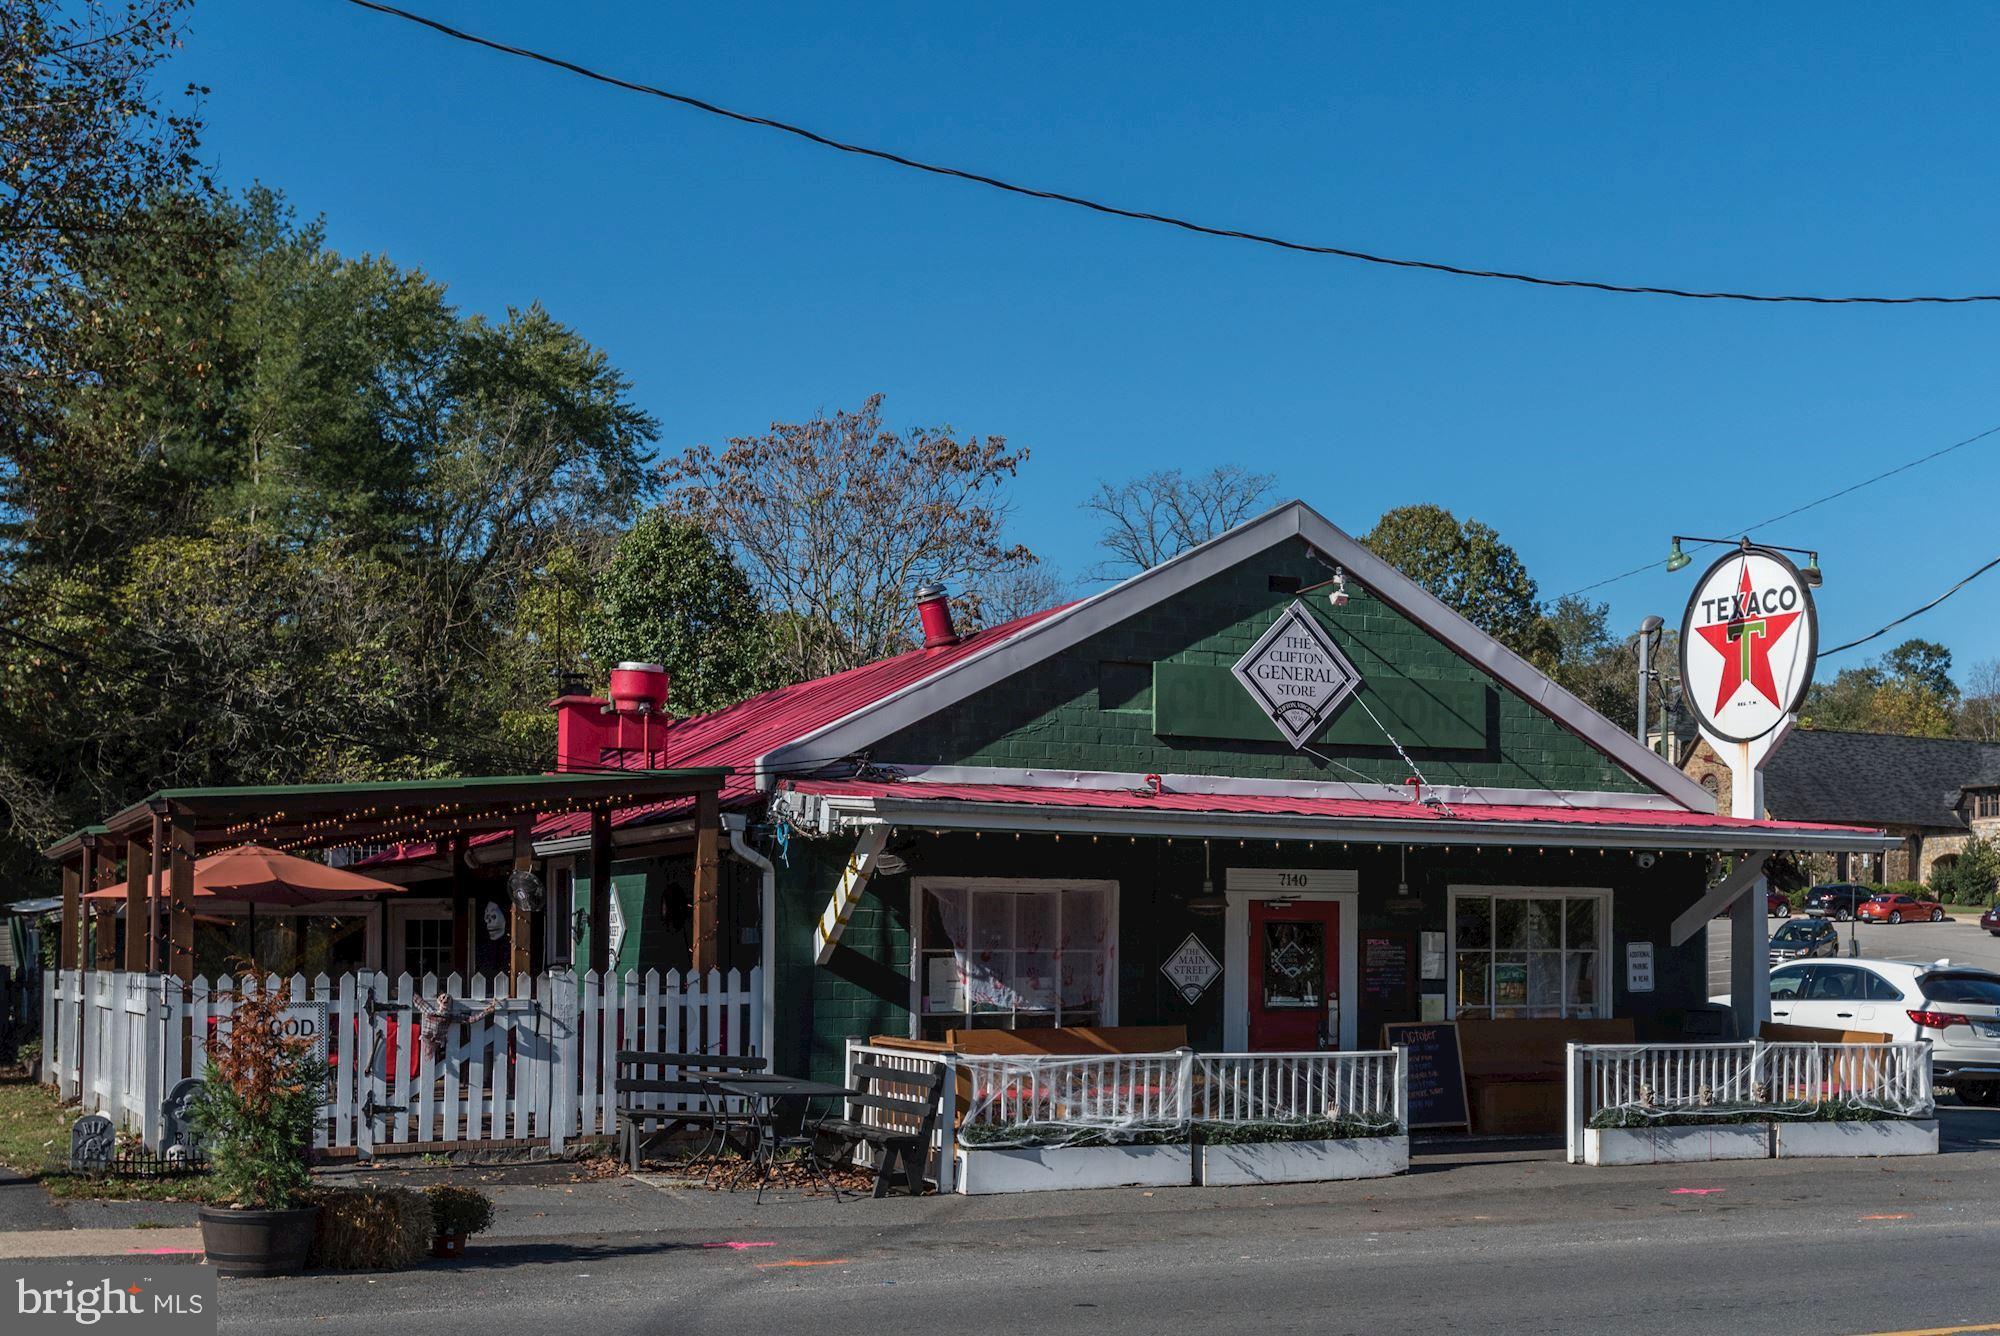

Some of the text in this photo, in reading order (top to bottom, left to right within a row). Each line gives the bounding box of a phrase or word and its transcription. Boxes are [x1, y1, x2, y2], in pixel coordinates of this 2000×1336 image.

[1701, 585, 1797, 624] TEXACO
[1284, 636, 1312, 650] THE
[1269, 650, 1324, 665] CLIFTON
[1257, 664, 1336, 684] GENERAL
[1277, 683, 1317, 698] STORE
[1278, 873, 1307, 887] 7140
[1185, 948, 1199, 956] THE
[1178, 956, 1206, 965] MAIN
[1174, 965, 1211, 975] STREET
